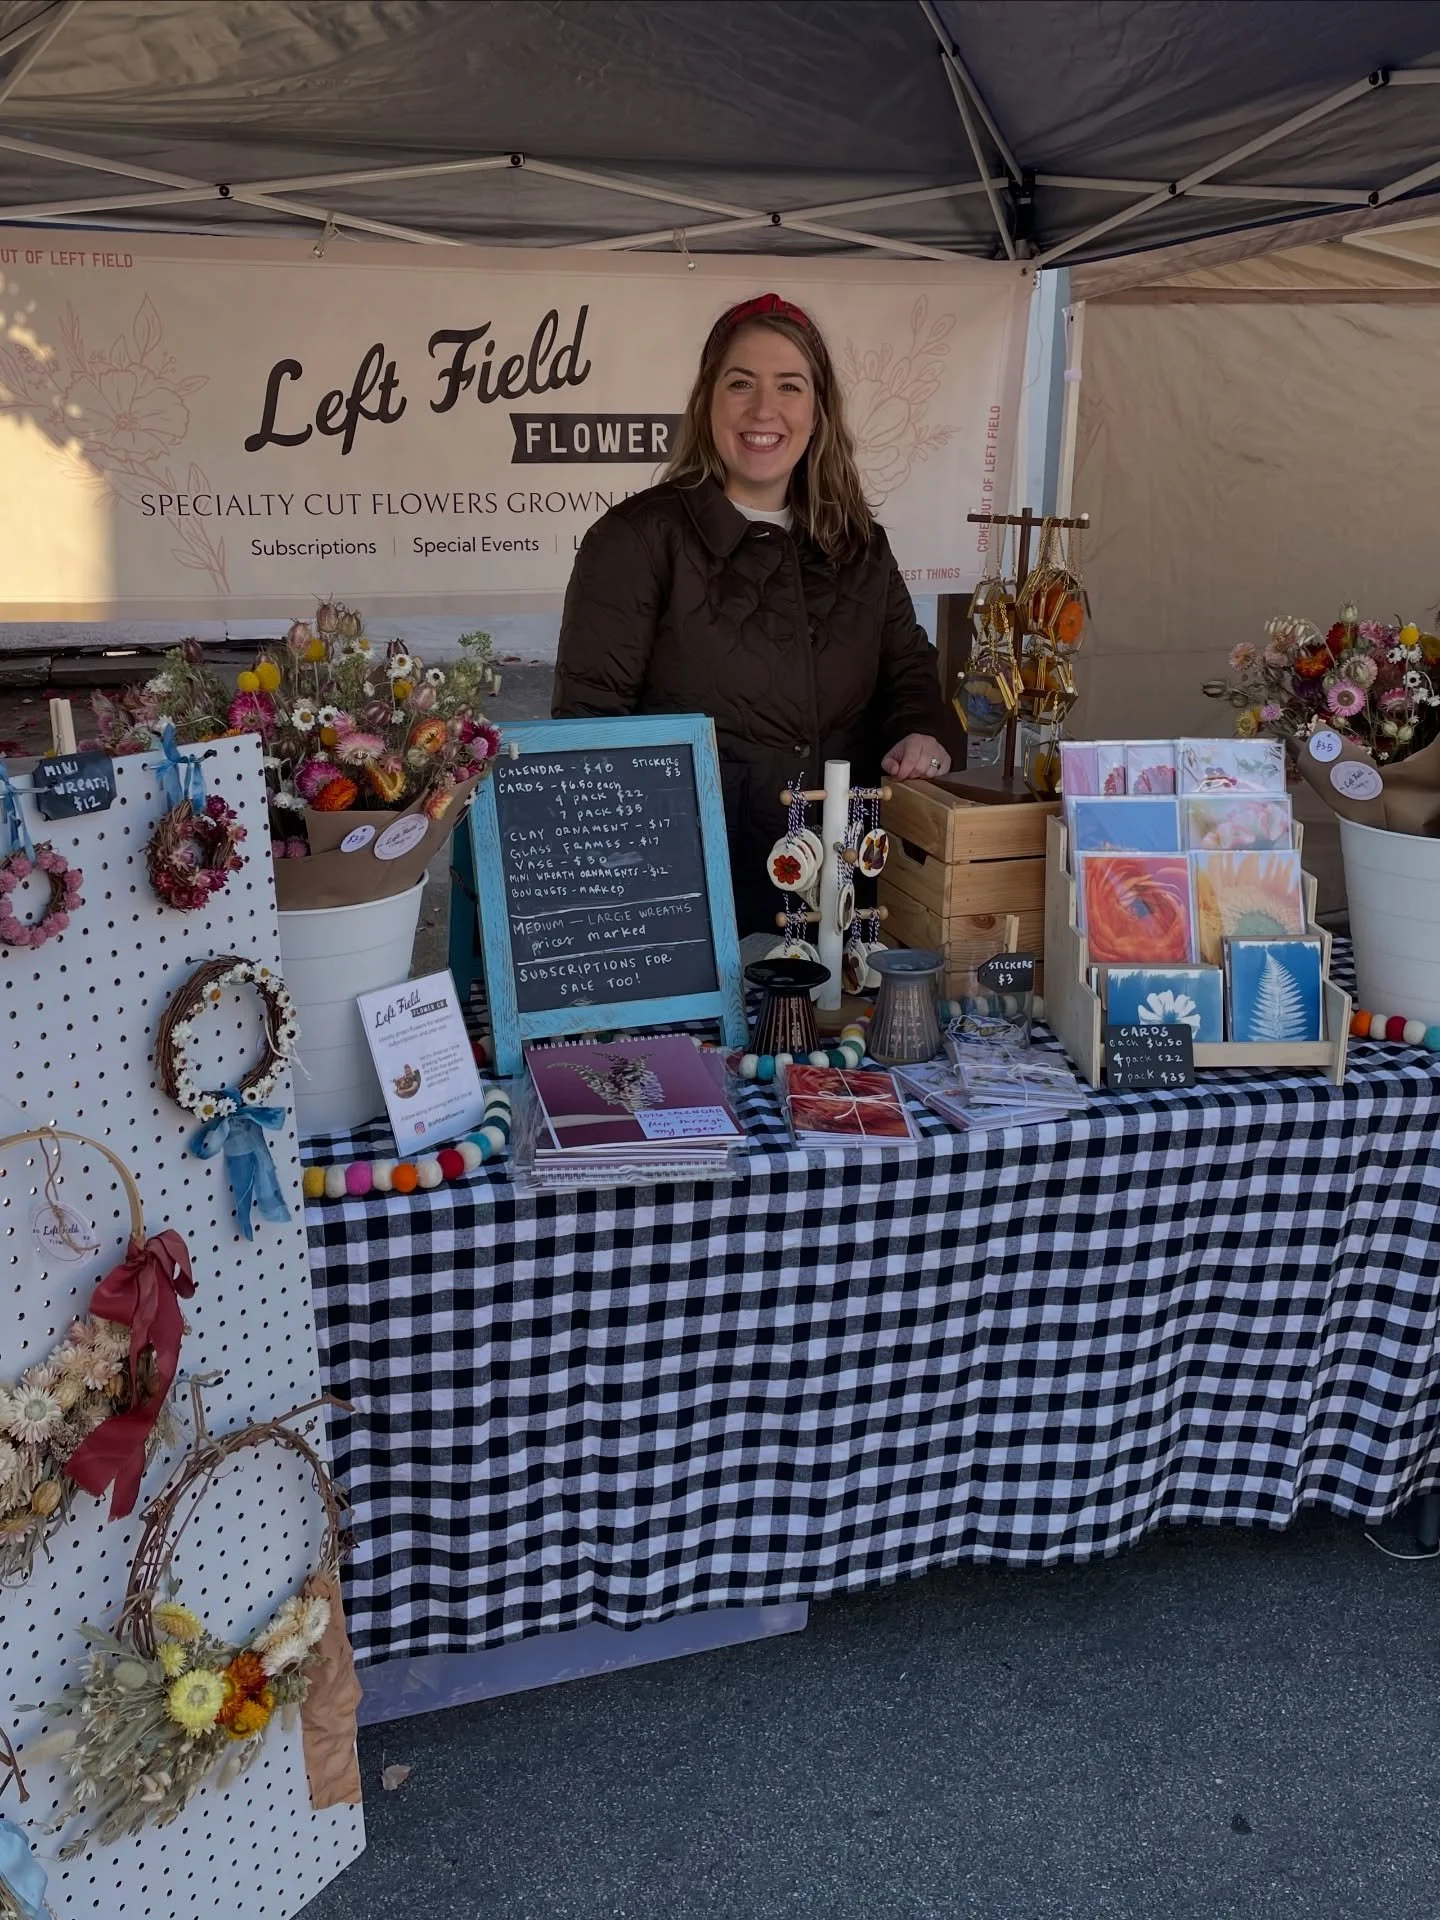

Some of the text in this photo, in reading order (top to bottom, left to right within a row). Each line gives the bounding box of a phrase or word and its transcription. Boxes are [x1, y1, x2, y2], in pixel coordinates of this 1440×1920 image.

[0, 249, 133, 268] UT OF LEFT FIELD
[244, 304, 592, 455] Left Field
[987, 405, 1000, 439] FIELD
[526, 423, 669, 454] FLOWER
[984, 444, 997, 473] LEFT
[982, 477, 994, 492] OF
[141, 491, 613, 516] SPECIALTY CUT FLOWERS GROWN
[977, 523, 990, 553] COME
[251, 536, 539, 559] Subscriptions Special Events
[926, 567, 961, 580] THINGS
[44, 761, 79, 776] MINI
[499, 764, 564, 779] CALENDAR
[583, 762, 614, 775] $40
[665, 766, 681, 778] $3
[499, 781, 544, 793] CARDS
[561, 779, 593, 794] $6.50
[597, 780, 622, 791] each
[73, 795, 101, 811] $12
[555, 789, 644, 806] 4 PACK $22
[560, 803, 643, 821] 7 PACK $35
[510, 828, 544, 841] CLAY
[555, 821, 629, 837] ORNAMENT
[649, 818, 670, 830] $17
[510, 844, 551, 859] GLASS
[562, 839, 621, 855] FRAMES
[640, 835, 659, 847] $17
[515, 859, 554, 871] VASE
[573, 855, 607, 867] $30
[509, 873, 529, 884] MINI
[580, 867, 639, 878] ORNAMENTS
[649, 864, 669, 878] $12
[511, 886, 567, 898] BOUQUETS
[512, 919, 565, 936] MEDIUM
[588, 910, 632, 926] LARGE
[639, 902, 692, 919] WREATHS
[531, 924, 646, 957] prices marked
[519, 953, 672, 982] SUBSCRIPTIONS FOR
[560, 972, 640, 995] SALE TOO!
[998, 972, 1014, 986] $3
[375, 1004, 396, 1028] Left
[396, 988, 421, 1014] Field
[1120, 1026, 1169, 1037] CARDS
[1109, 1037, 1183, 1048] each $6.50
[1113, 1052, 1183, 1067] 4 pack $22
[1114, 1072, 1122, 1083] 7
[1160, 1071, 1186, 1084] $35
